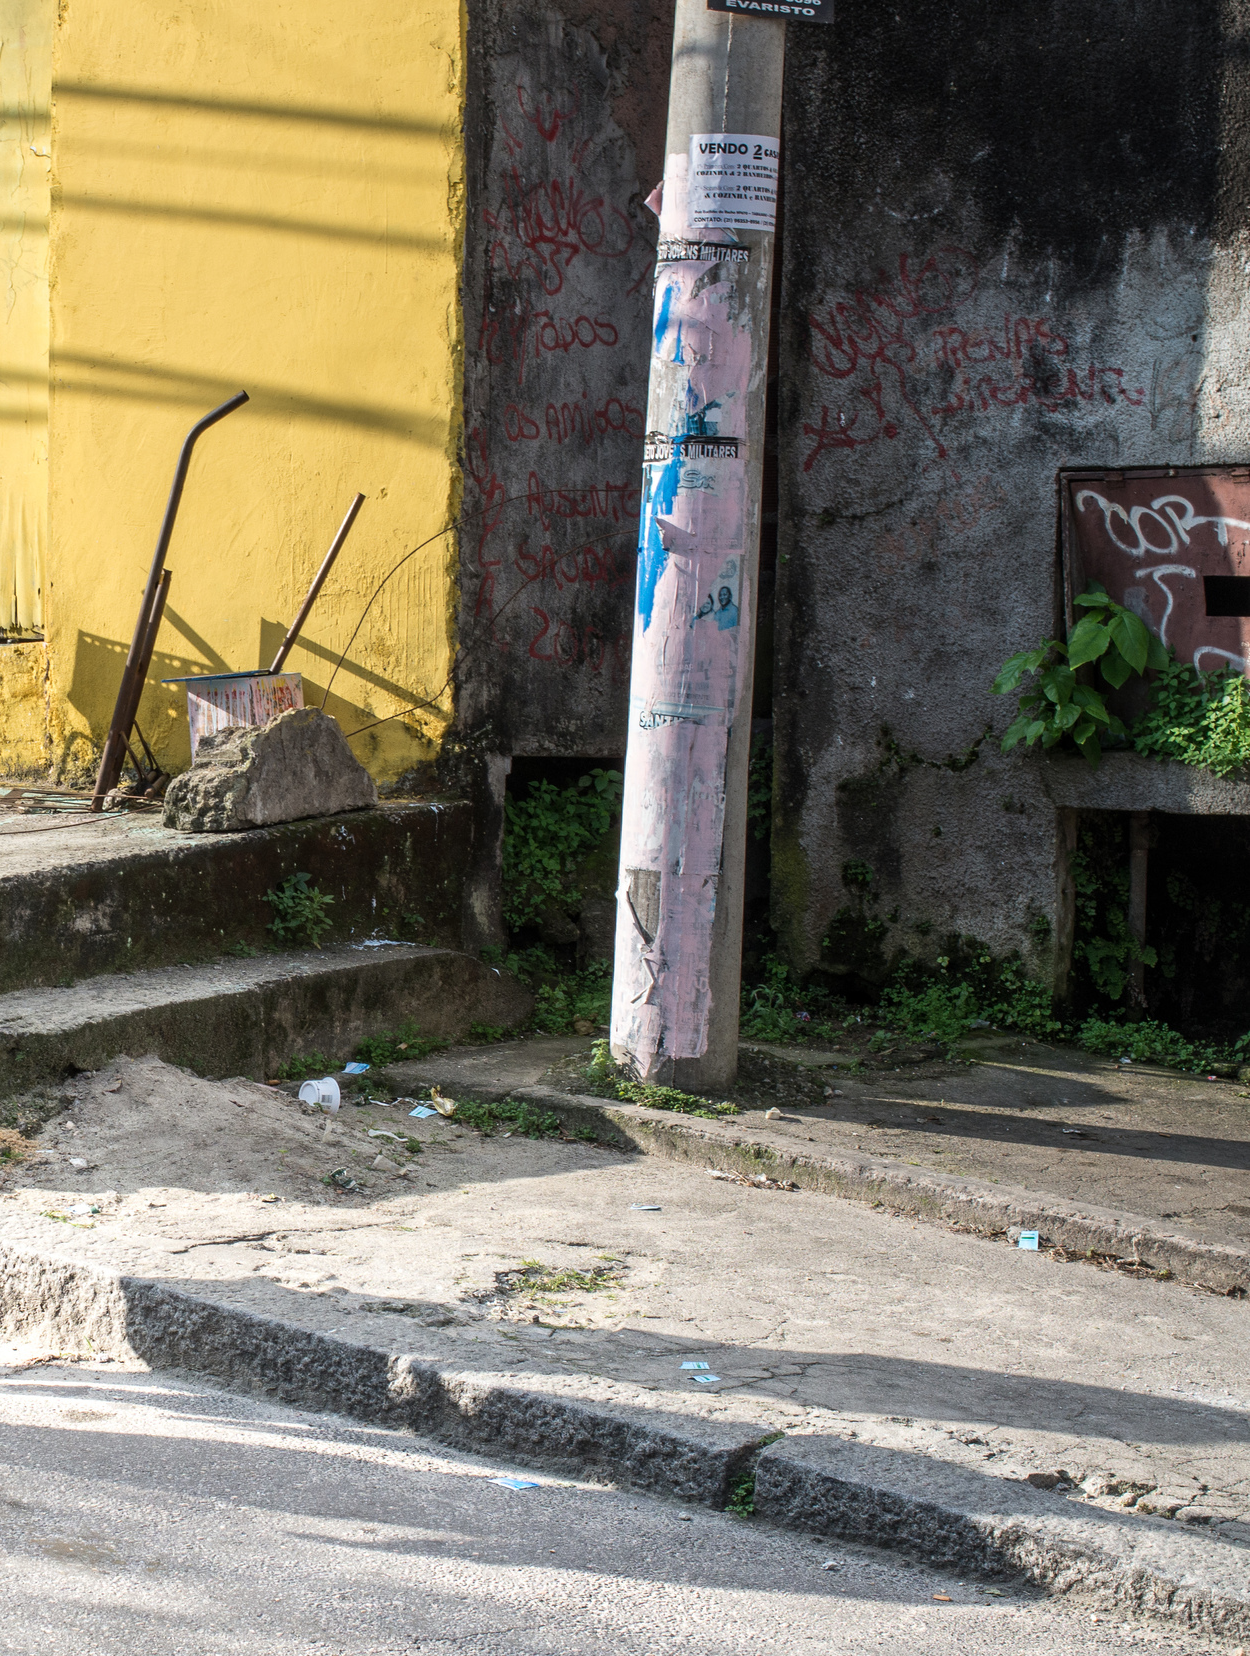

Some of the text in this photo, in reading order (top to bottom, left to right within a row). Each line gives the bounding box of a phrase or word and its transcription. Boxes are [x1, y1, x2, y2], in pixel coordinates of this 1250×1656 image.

[726, 0, 815, 16] EVARISTO
[699, 143, 748, 155] VENDO
[753, 144, 763, 159] 2
[713, 192, 748, 200] COZINHA
[700, 245, 749, 262] MILITARES
[655, 444, 686, 460] JOVES
[688, 444, 737, 459] MILITARES
